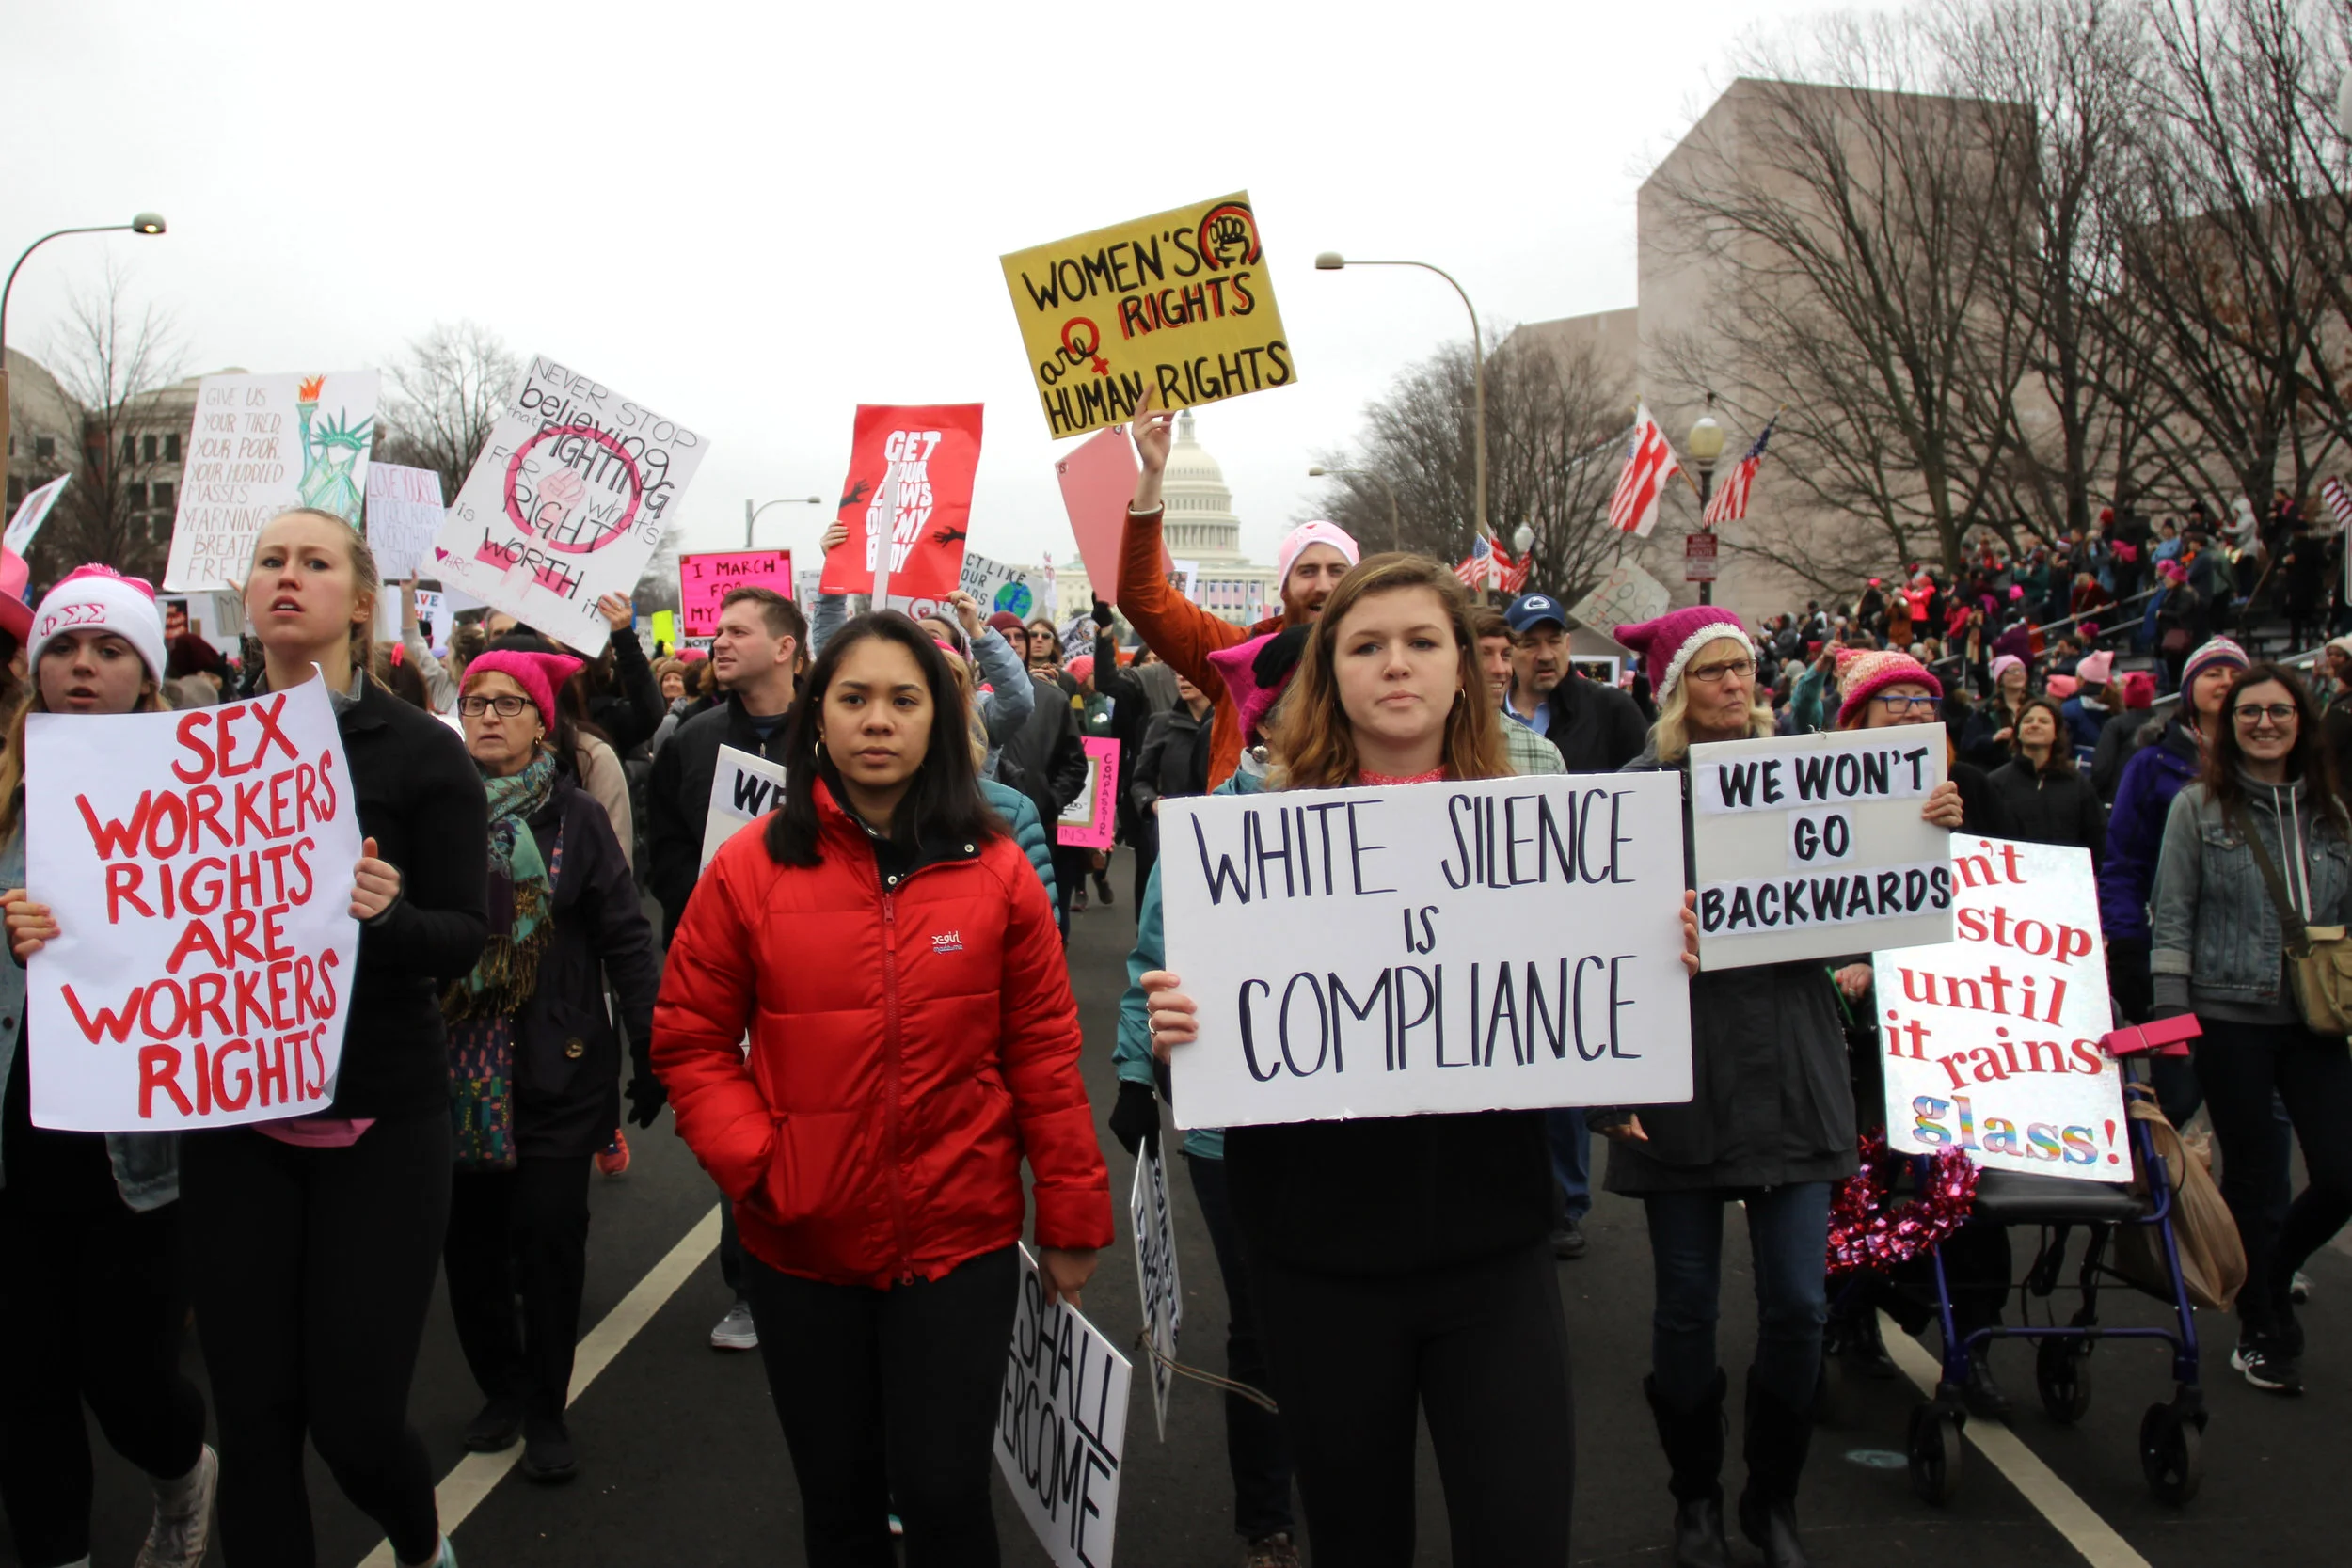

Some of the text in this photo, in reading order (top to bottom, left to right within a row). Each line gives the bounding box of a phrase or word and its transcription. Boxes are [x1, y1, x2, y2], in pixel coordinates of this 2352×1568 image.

[1022, 227, 1201, 311] WOMEN'S
[1117, 272, 1256, 340] RIGHTS
[1039, 336, 1101, 385] are
[1043, 340, 1290, 435] HUMAN RIGHTS
[203, 412, 236, 433] YOUR
[206, 387, 266, 406] GIVE US
[531, 357, 697, 449] NEVER STOP
[195, 436, 231, 459] YOUR
[507, 403, 675, 519] that FIGHTING
[519, 377, 670, 491] believing
[884, 430, 941, 461] GET
[186, 483, 250, 504] MASSES
[190, 462, 284, 483] YOUR HUDDLED
[488, 445, 660, 545] FOR what's
[183, 505, 268, 531] YEARNING
[457, 502, 476, 522] is
[502, 483, 621, 553] RIGHT
[892, 506, 933, 543] MY
[194, 533, 258, 556] BREATH
[445, 554, 473, 577] HRC
[484, 527, 585, 599] WORTH
[693, 559, 775, 578] I MARCH
[866, 534, 914, 573] BDY
[965, 552, 984, 568] CT
[987, 561, 1026, 586] LIKE
[691, 608, 715, 623] MY
[958, 584, 988, 606] IDS
[171, 692, 299, 784] SEX
[74, 749, 337, 862] WORKERS
[1719, 746, 1929, 808] WE WON'T
[1190, 787, 1636, 906] WHITE SILENCE
[1794, 814, 1850, 861] GO
[1951, 839, 2027, 898] n't
[105, 835, 316, 925] RIGHTS
[1701, 866, 1951, 932] BACKWARDS
[165, 903, 295, 974] ARE
[1403, 905, 1440, 955] IS
[1957, 905, 2093, 966] stop
[61, 947, 340, 1045] WORKERS
[1238, 954, 1642, 1082] COMPLIANCE
[1897, 965, 2067, 1028] until
[138, 1022, 327, 1119] RIGHTS
[1884, 1009, 2104, 1091] it rains
[1912, 1094, 2120, 1165] glass!
[1020, 1270, 1118, 1470] SHALL
[997, 1348, 1111, 1568] ERCOME
